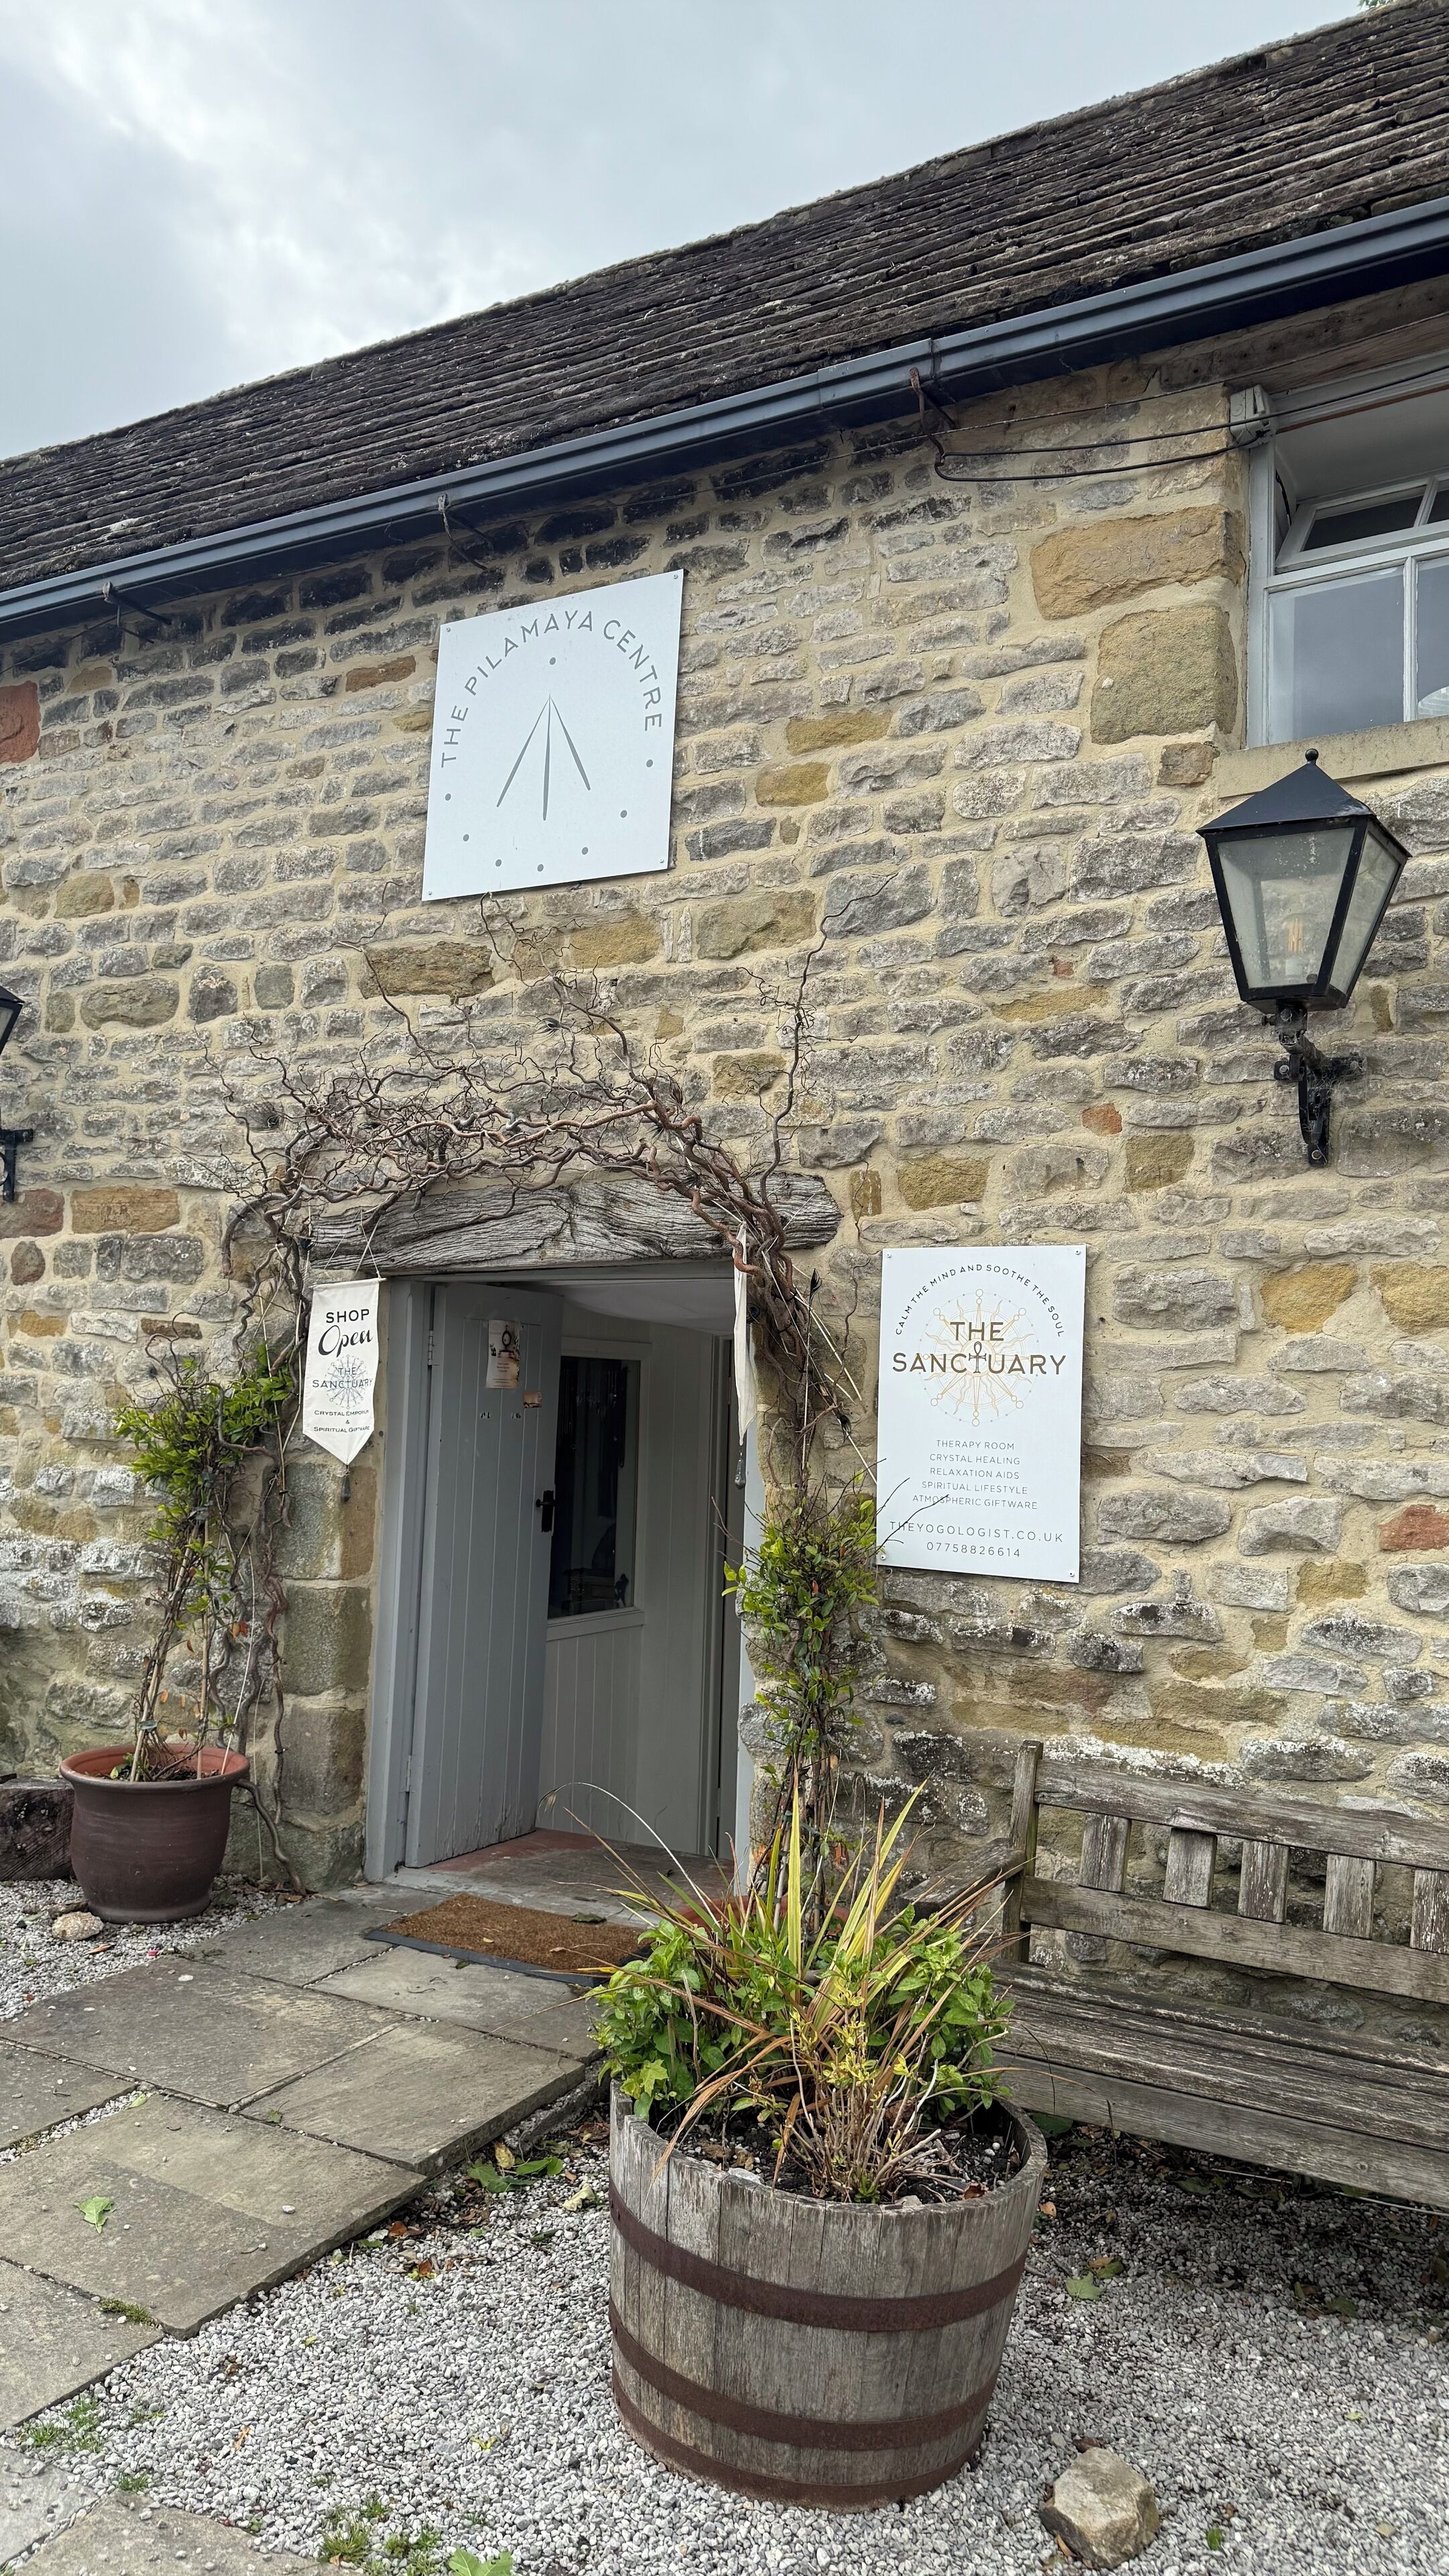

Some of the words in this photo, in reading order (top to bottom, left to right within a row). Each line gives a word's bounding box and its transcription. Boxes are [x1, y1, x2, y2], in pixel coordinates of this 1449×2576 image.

[441, 705, 468, 768] THE
[464, 610, 593, 696] PILAMAYA
[603, 619, 662, 732] CENTRE
[896, 1305, 912, 1335] CALM
[911, 1285, 929, 1303] THE
[930, 1269, 956, 1287] MIND
[960, 1264, 982, 1273] AND
[986, 1265, 1031, 1287] SOOTHE
[1032, 1285, 1050, 1305] THE
[1048, 1305, 1065, 1337] SOUL
[326, 1309, 370, 1324] SHOP
[950, 1322, 1004, 1342] THE
[318, 1325, 374, 1358] Open
[892, 1342, 1067, 1375] SANCTUARY
[338, 1366, 357, 1376] THE
[312, 1376, 373, 1389] SANCTUARY
[936, 1440, 981, 1448] THERAPY
[984, 1442, 1015, 1450] ROOM
[930, 1454, 973, 1463] CRYSTAL
[975, 1456, 1020, 1465] HEALING
[930, 1467, 993, 1478] RELAXATION
[996, 1471, 1020, 1480] AIDS
[922, 1481, 971, 1491] SPIRITUAL
[974, 1485, 1028, 1495] LIFESTYLE
[912, 1495, 981, 1506] ATMOSPHERIC
[984, 1499, 1038, 1509] GIFTWARE
[890, 1521, 1063, 1543] THEYOGOLOGIST.CO.UK
[926, 1542, 1020, 1557] 07758826614
